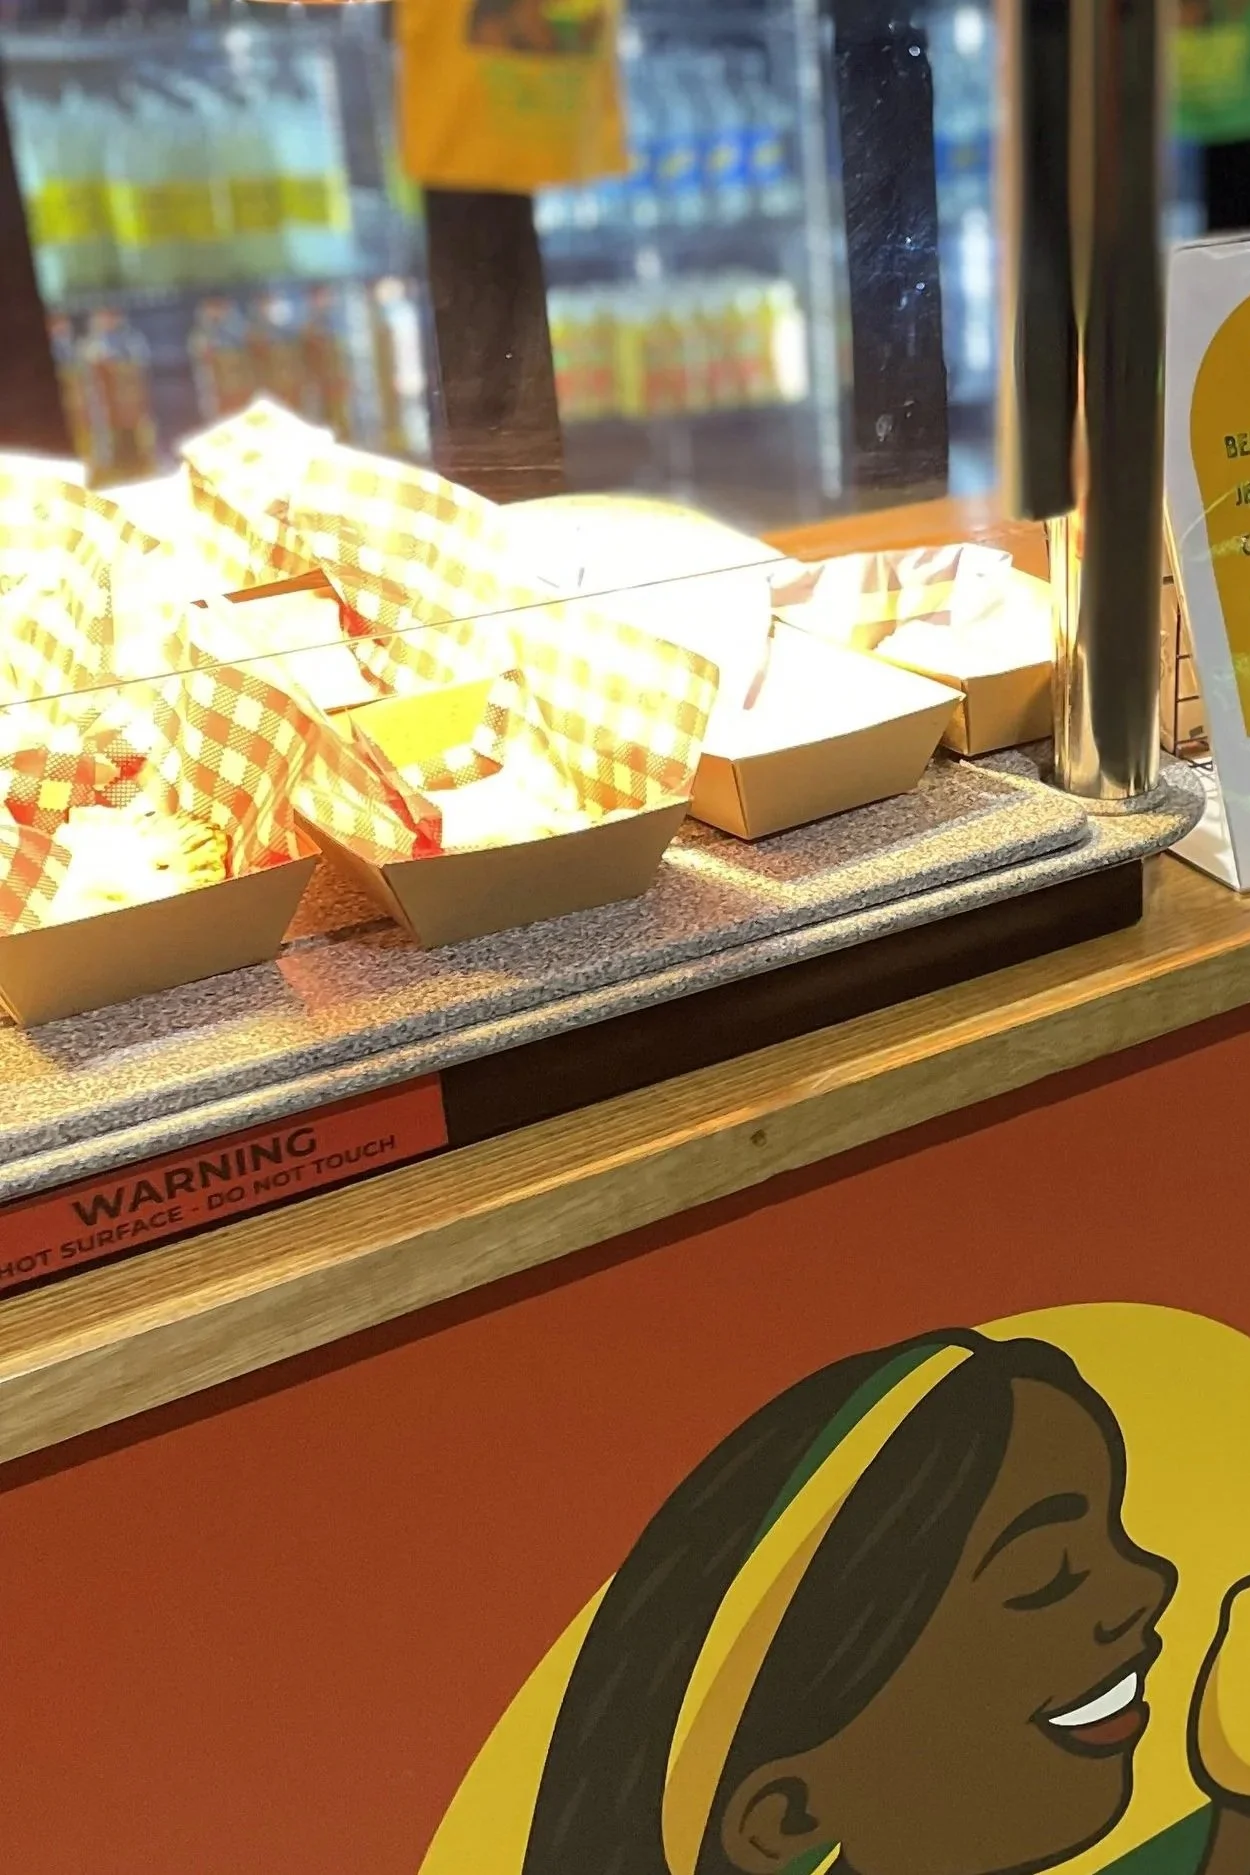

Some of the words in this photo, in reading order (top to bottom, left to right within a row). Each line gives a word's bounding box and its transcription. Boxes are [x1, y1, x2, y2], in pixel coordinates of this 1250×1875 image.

[0, 1249, 52, 1278] HOT
[60, 1206, 184, 1259] SURFACE
[207, 1185, 246, 1212] DO
[253, 1168, 304, 1194] NOT
[313, 1134, 397, 1175] TOUCH
[73, 1126, 317, 1227] WARNING
